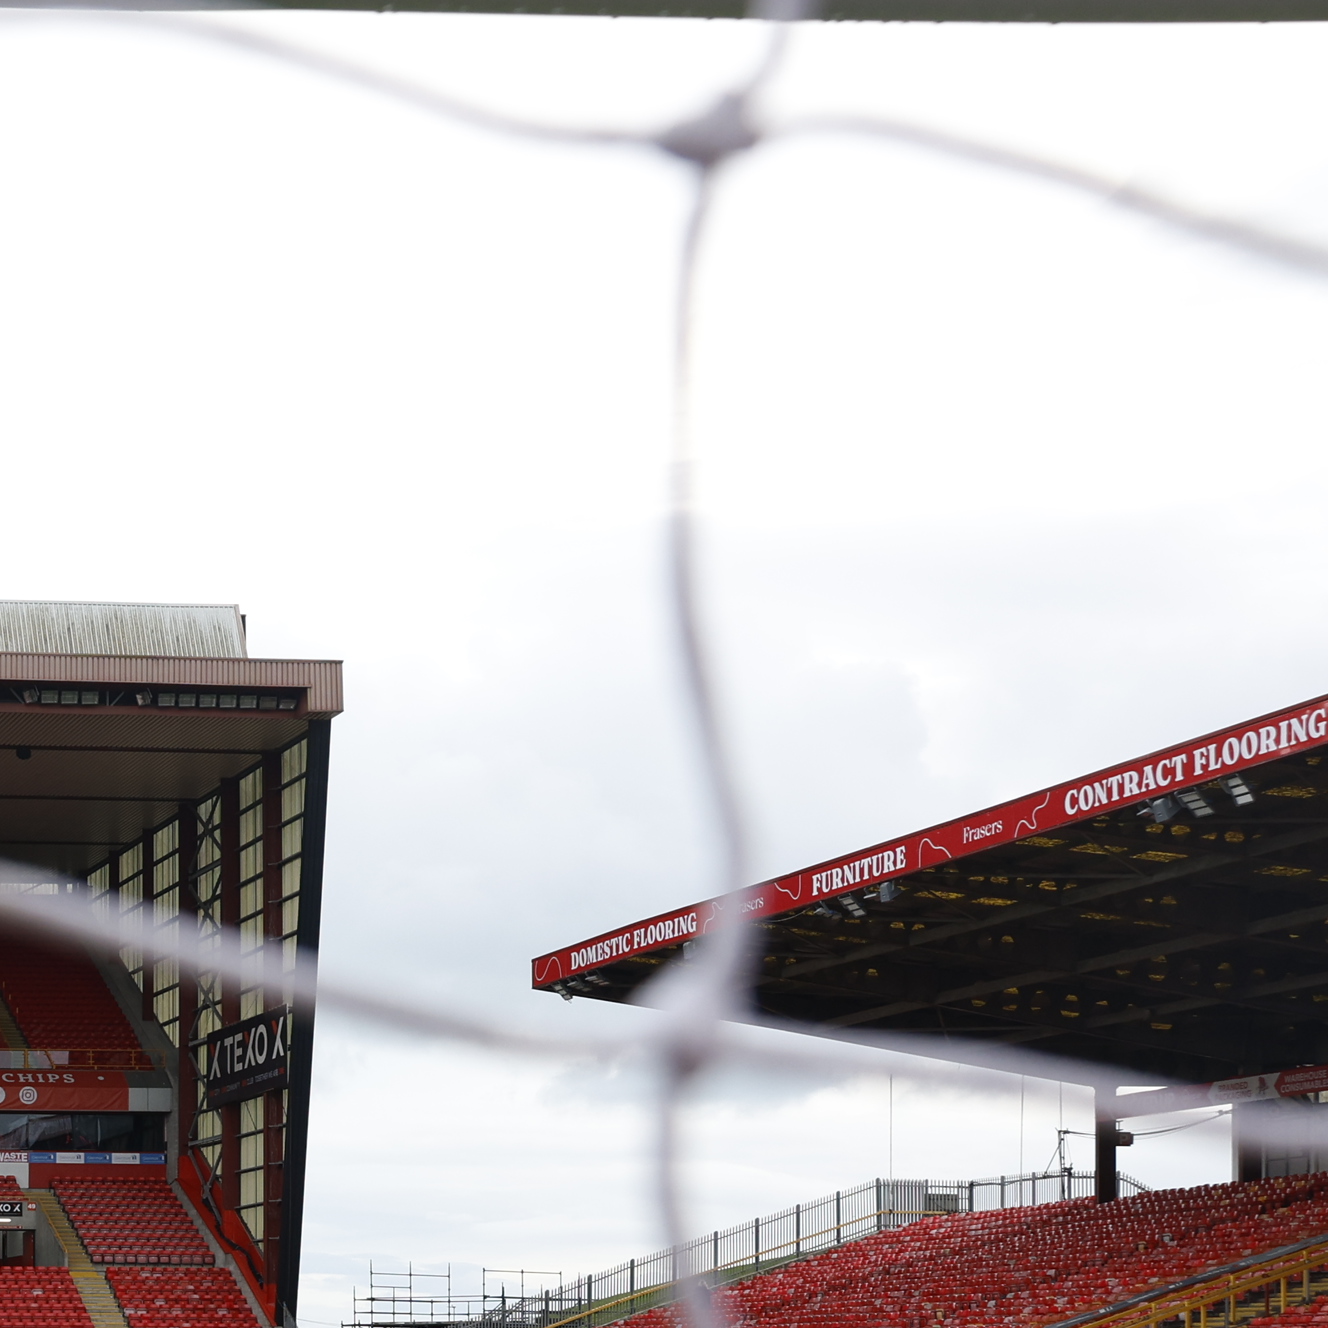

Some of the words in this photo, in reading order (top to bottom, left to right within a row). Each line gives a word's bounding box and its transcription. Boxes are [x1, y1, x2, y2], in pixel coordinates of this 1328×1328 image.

[1064, 753, 1186, 815] CONTRACT
[1193, 708, 1327, 776] FLOORING
[962, 820, 1003, 844] Frasers
[811, 845, 906, 896] FURNITURE
[570, 932, 631, 970] DOMESTIC
[633, 912, 697, 949] FLOORING
[224, 1024, 268, 1074] TEXO
[1, 1073, 75, 1083] CHIPS
